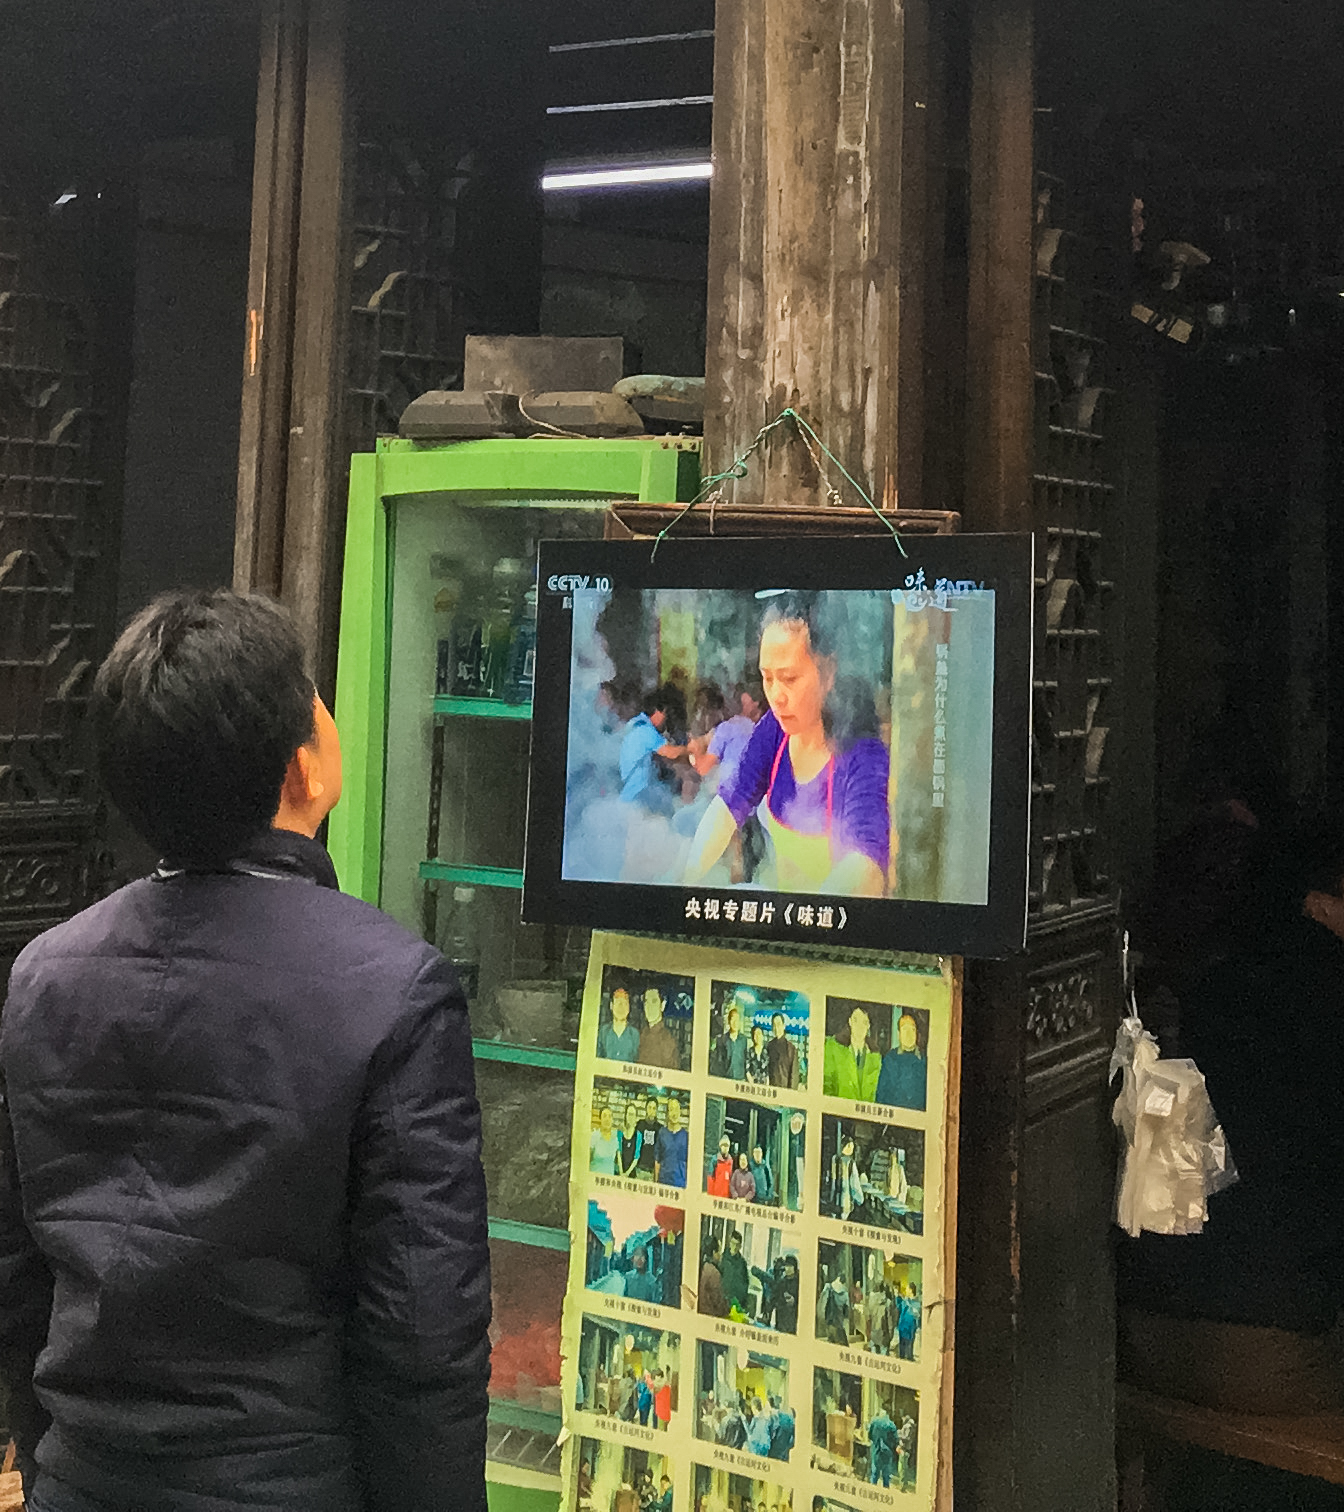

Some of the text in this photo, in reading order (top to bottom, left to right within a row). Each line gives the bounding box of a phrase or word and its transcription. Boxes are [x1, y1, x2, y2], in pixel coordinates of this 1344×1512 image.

[547, 574, 590, 591] CCTV
[684, 896, 848, 930] 央视专题片《味道》
